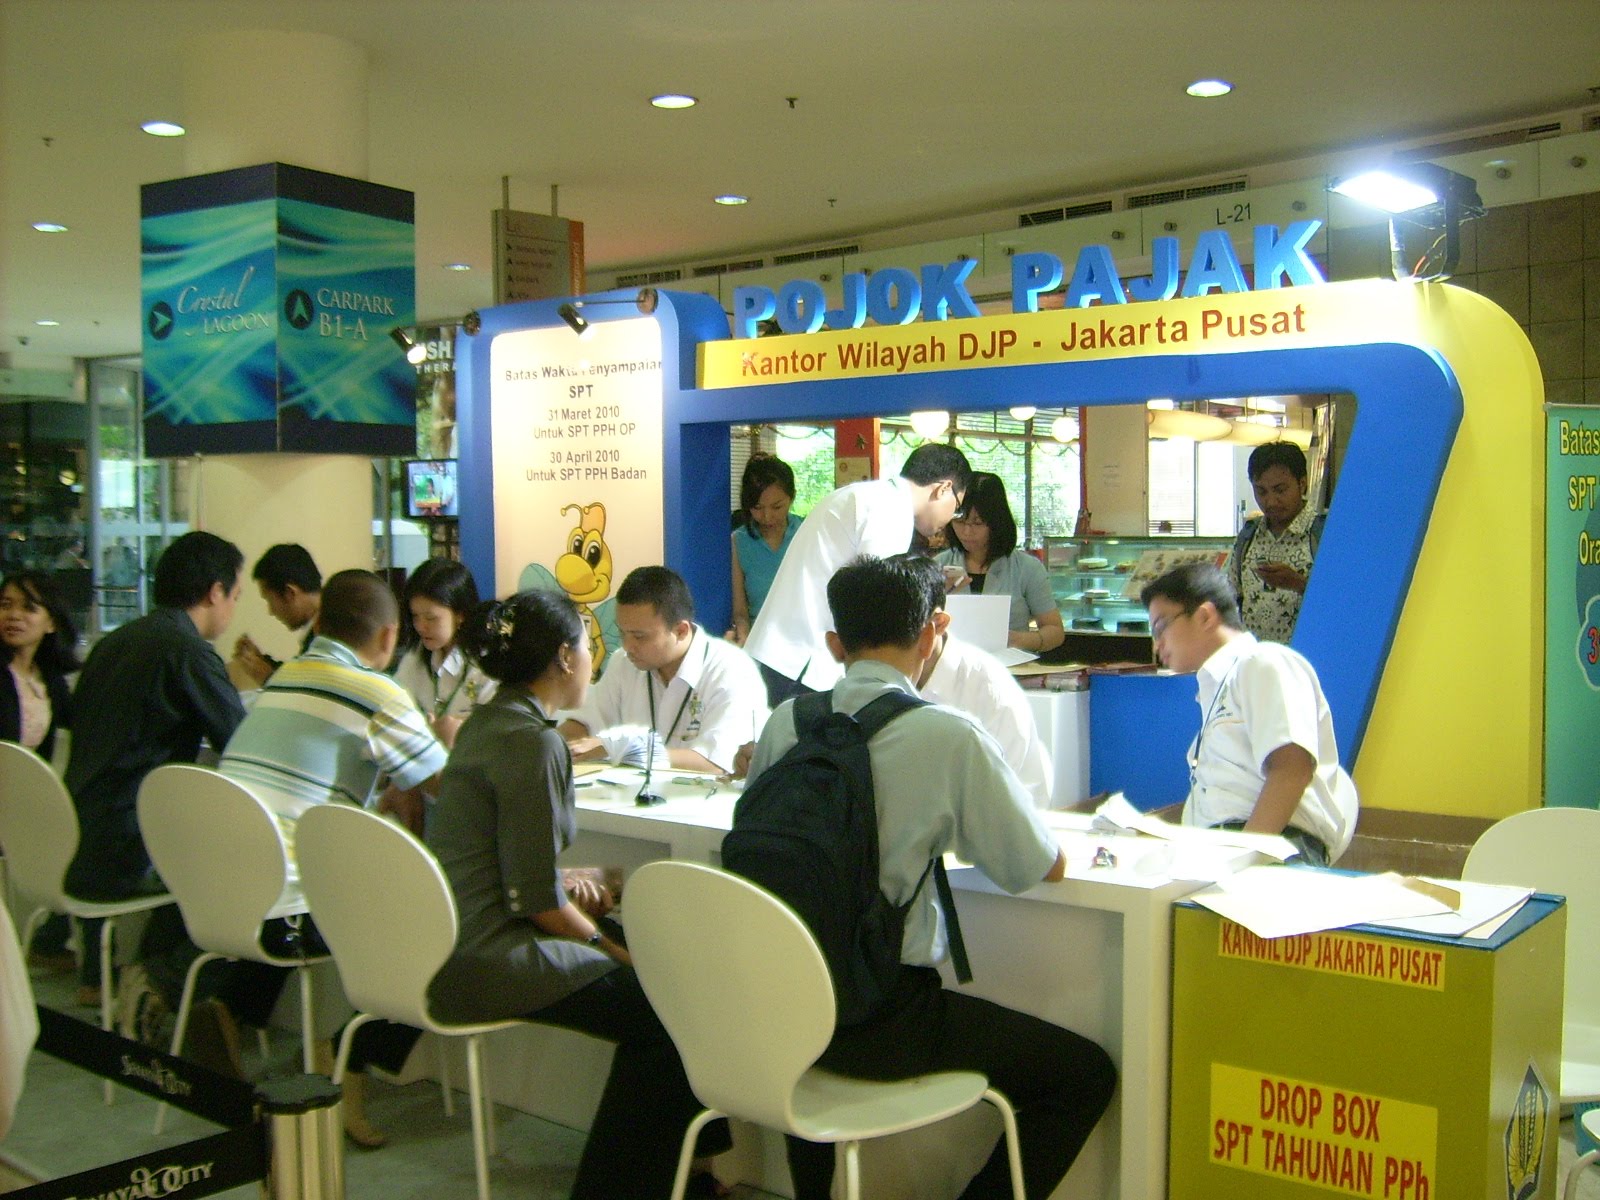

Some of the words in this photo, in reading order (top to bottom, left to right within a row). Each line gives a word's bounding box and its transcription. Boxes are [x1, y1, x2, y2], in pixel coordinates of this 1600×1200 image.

[1216, 202, 1251, 225] L-21
[733, 258, 982, 338] POJOK
[1011, 220, 1327, 313] PAJAK
[317, 288, 394, 316] CARPARK
[204, 312, 270, 334] LAGOON
[320, 312, 368, 341] B1-A
[415, 341, 452, 360] SH
[742, 349, 827, 377] Kantor
[838, 336, 946, 373] Wilayah
[959, 329, 1017, 361] DJP
[1061, 315, 1189, 352] Jakarta
[1202, 304, 1306, 339] Pusat
[505, 369, 538, 381] Batas
[581, 358, 662, 377] enyampaia
[569, 384, 594, 399] SPT
[548, 409, 558, 421] 31
[561, 408, 592, 420] Maret
[596, 405, 620, 419] 2010
[534, 426, 563, 439] Untuk
[568, 424, 590, 438] SPT
[593, 423, 616, 436] PPH
[620, 422, 636, 436] OP
[550, 451, 562, 464] 30
[566, 450, 592, 466] April
[595, 449, 620, 463] 2010
[526, 468, 556, 481] Untuk
[560, 468, 582, 480] SPT
[585, 467, 608, 480] PPH
[611, 466, 647, 480] Badan
[1568, 475, 1597, 511] SPT
[1222, 922, 1280, 962] KANWIL
[1284, 933, 1312, 966] DJP
[1314, 935, 1385, 978] JAKARTA
[1389, 946, 1443, 986] PUSAT
[1260, 1079, 1323, 1129] DROP
[1333, 1092, 1381, 1143] BOX
[1214, 1119, 1253, 1166] SPT
[1261, 1129, 1374, 1195] TAHUNAN
[1384, 1156, 1429, 1200] PPh
